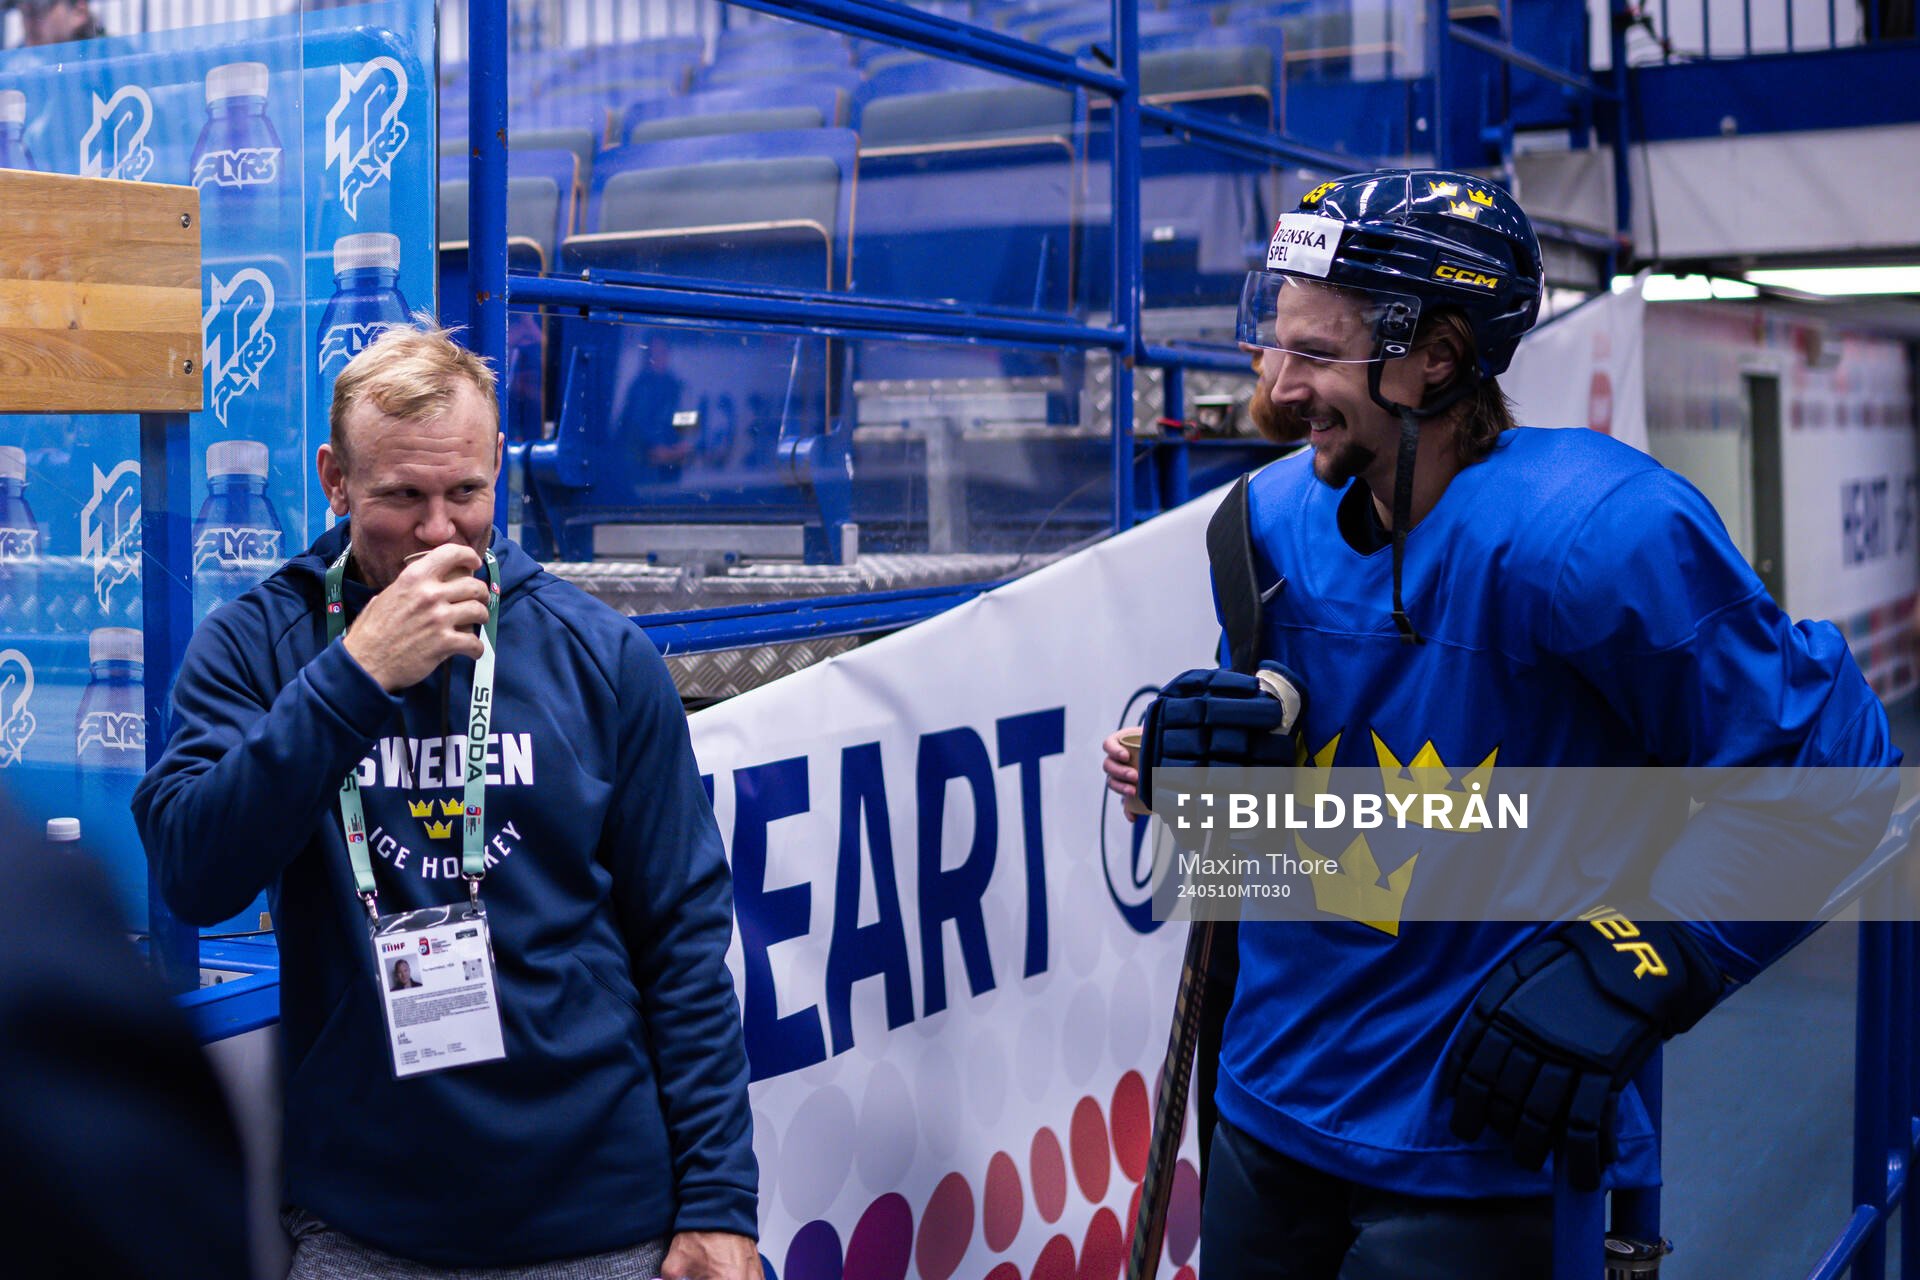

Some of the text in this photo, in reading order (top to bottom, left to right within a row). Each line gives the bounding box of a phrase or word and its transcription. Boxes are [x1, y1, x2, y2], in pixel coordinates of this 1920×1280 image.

[1268, 245, 1288, 261] SPEL
[1435, 265, 1499, 289] CCM
[369, 820, 522, 879] ICE HOKEY
[700, 705, 1066, 1084] EART
